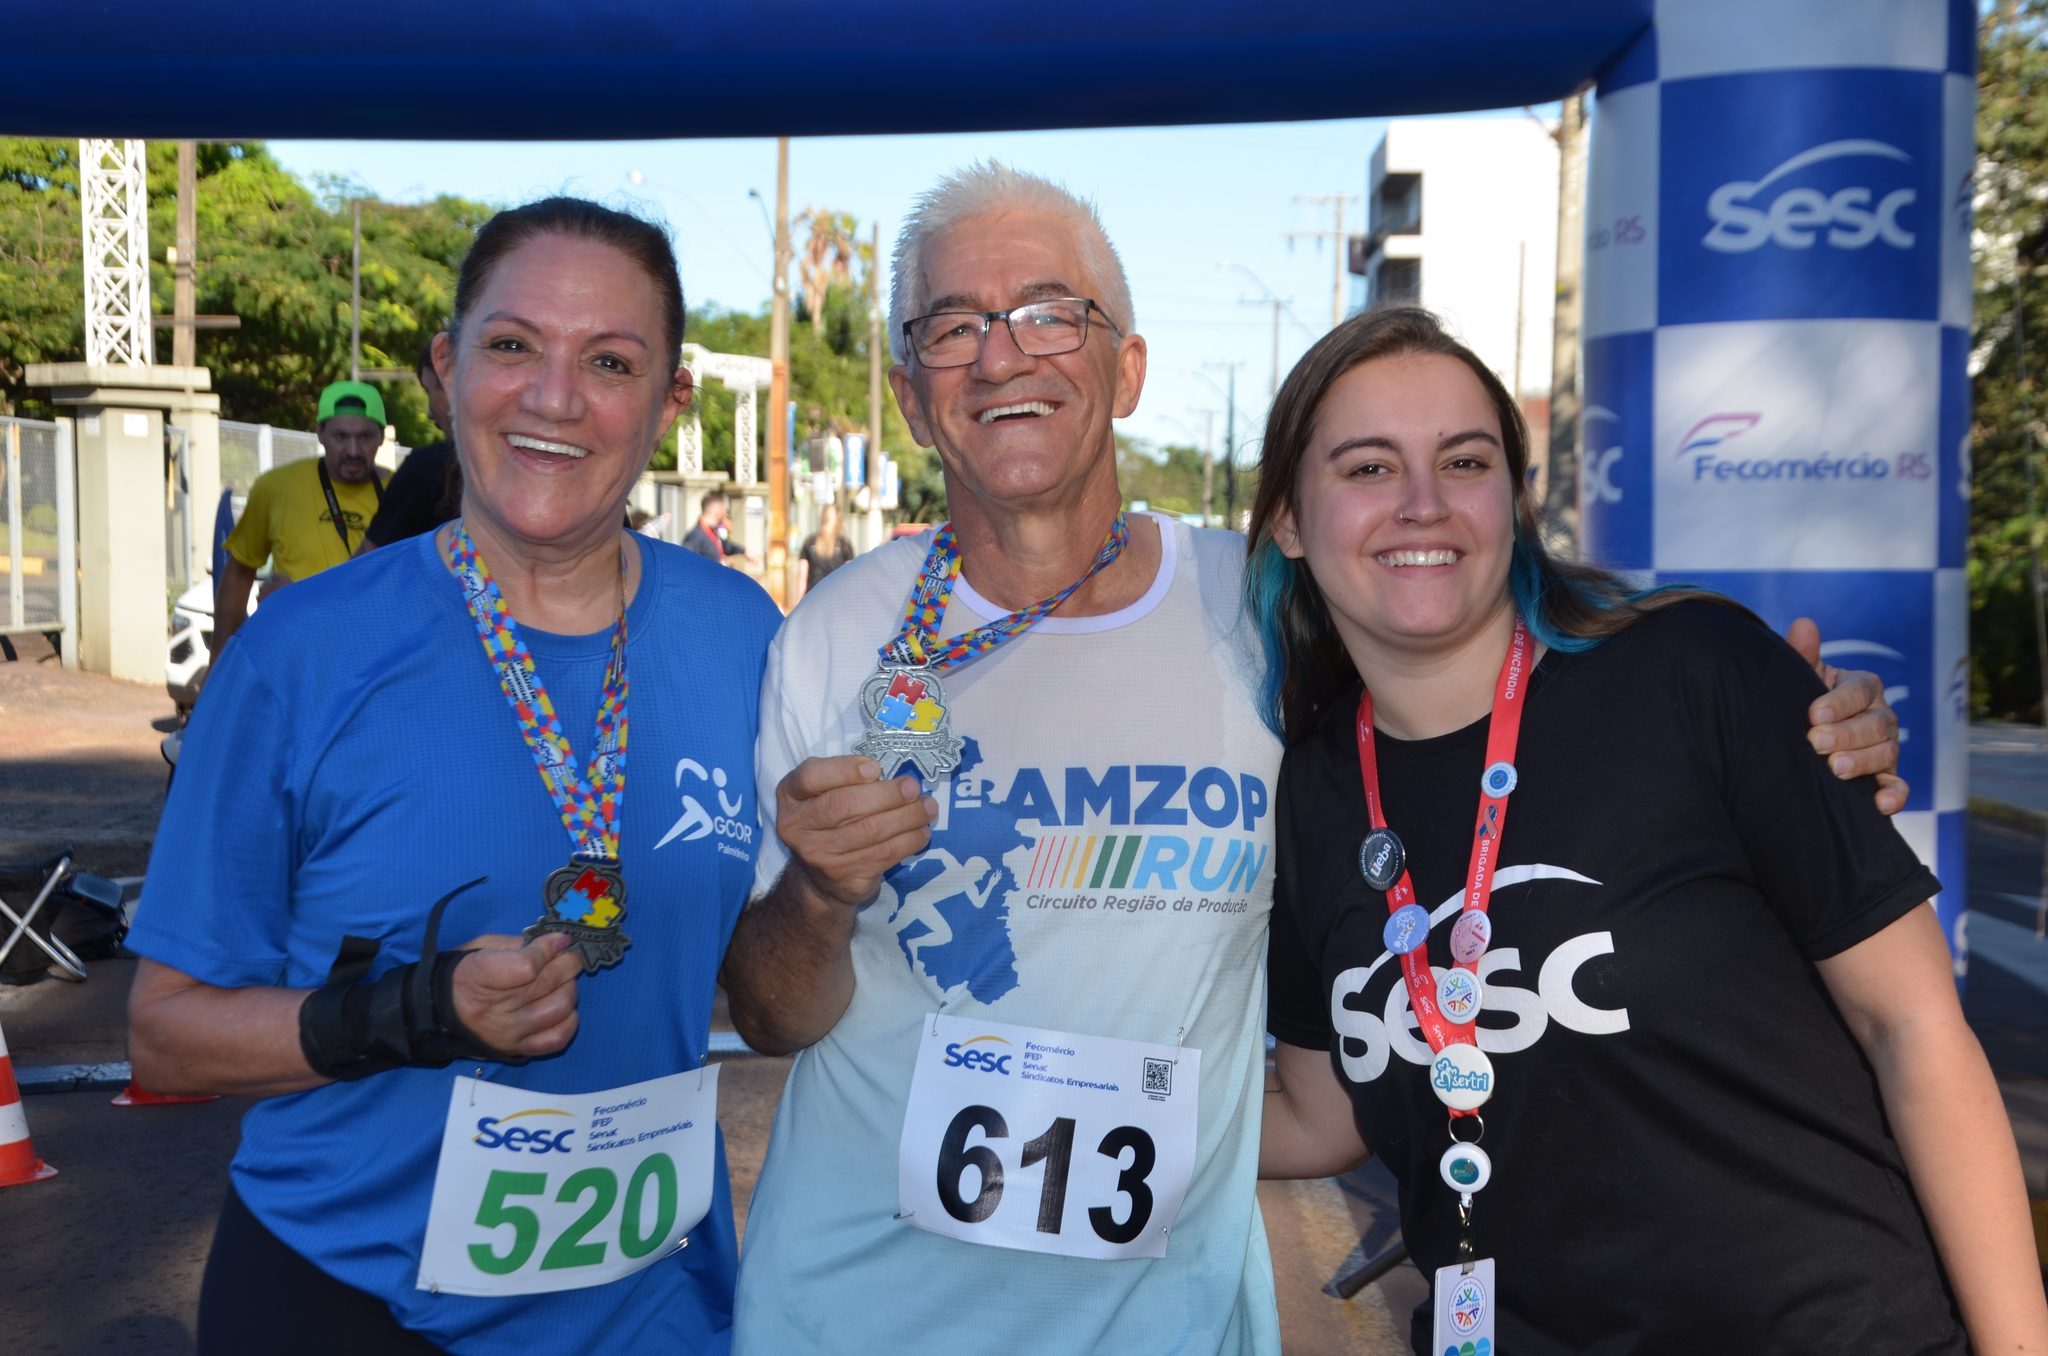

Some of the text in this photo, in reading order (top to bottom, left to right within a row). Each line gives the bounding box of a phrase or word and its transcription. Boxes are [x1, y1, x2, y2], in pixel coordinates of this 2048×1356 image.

[1703, 178, 1916, 253] Sesc
[1692, 451, 1889, 482] Fecomércio
[1895, 453, 1932, 480] RS
[1505, 648, 1522, 700] INCÊNDIO
[1006, 764, 1268, 832] AMZOP
[714, 816, 752, 844] GCOR
[1132, 834, 1267, 893] RUN
[1471, 839, 1490, 907] BRIGADA DE
[1026, 894, 1247, 916] Circuito Região da Produção
[943, 1042, 1012, 1076] Sesc
[1024, 1052, 1042, 1061] IFEP
[1025, 1041, 1075, 1056] Fecomércio
[1021, 1071, 1120, 1092] Sindicatos Empresariais
[1022, 1062, 1047, 1072] Senac
[472, 1116, 575, 1154] Sesc
[587, 1119, 693, 1152] Sindicatos Empresariais
[591, 1117, 612, 1128] IFEP
[936, 1104, 1156, 1244] 613
[467, 1152, 678, 1275] 520
